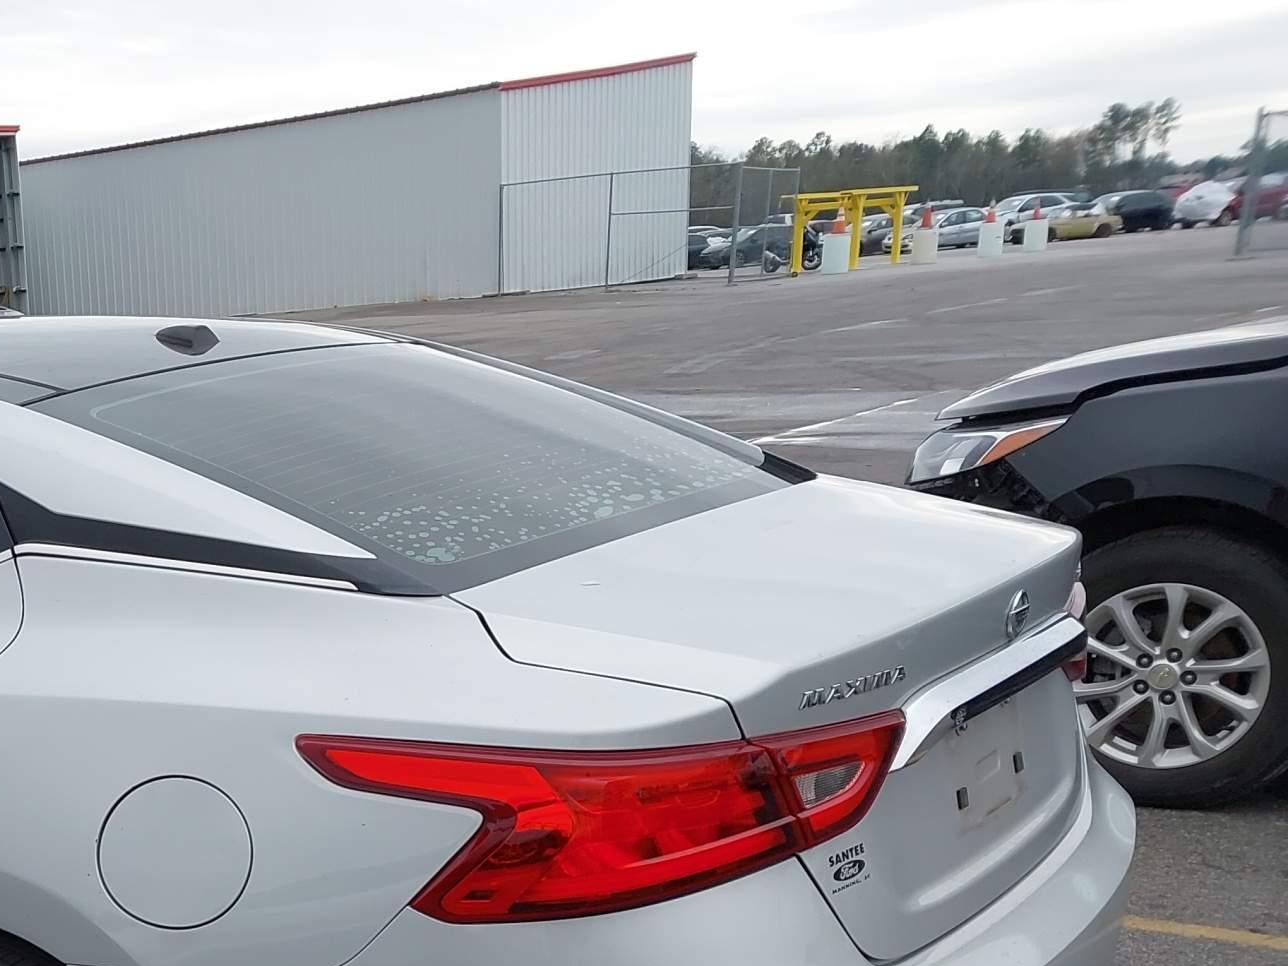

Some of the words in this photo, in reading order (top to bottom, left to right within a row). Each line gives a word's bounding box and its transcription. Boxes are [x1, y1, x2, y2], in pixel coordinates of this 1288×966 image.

[798, 664, 907, 711] MAXIMA
[828, 842, 865, 868] SANTEE
[838, 861, 862, 880] Ford
